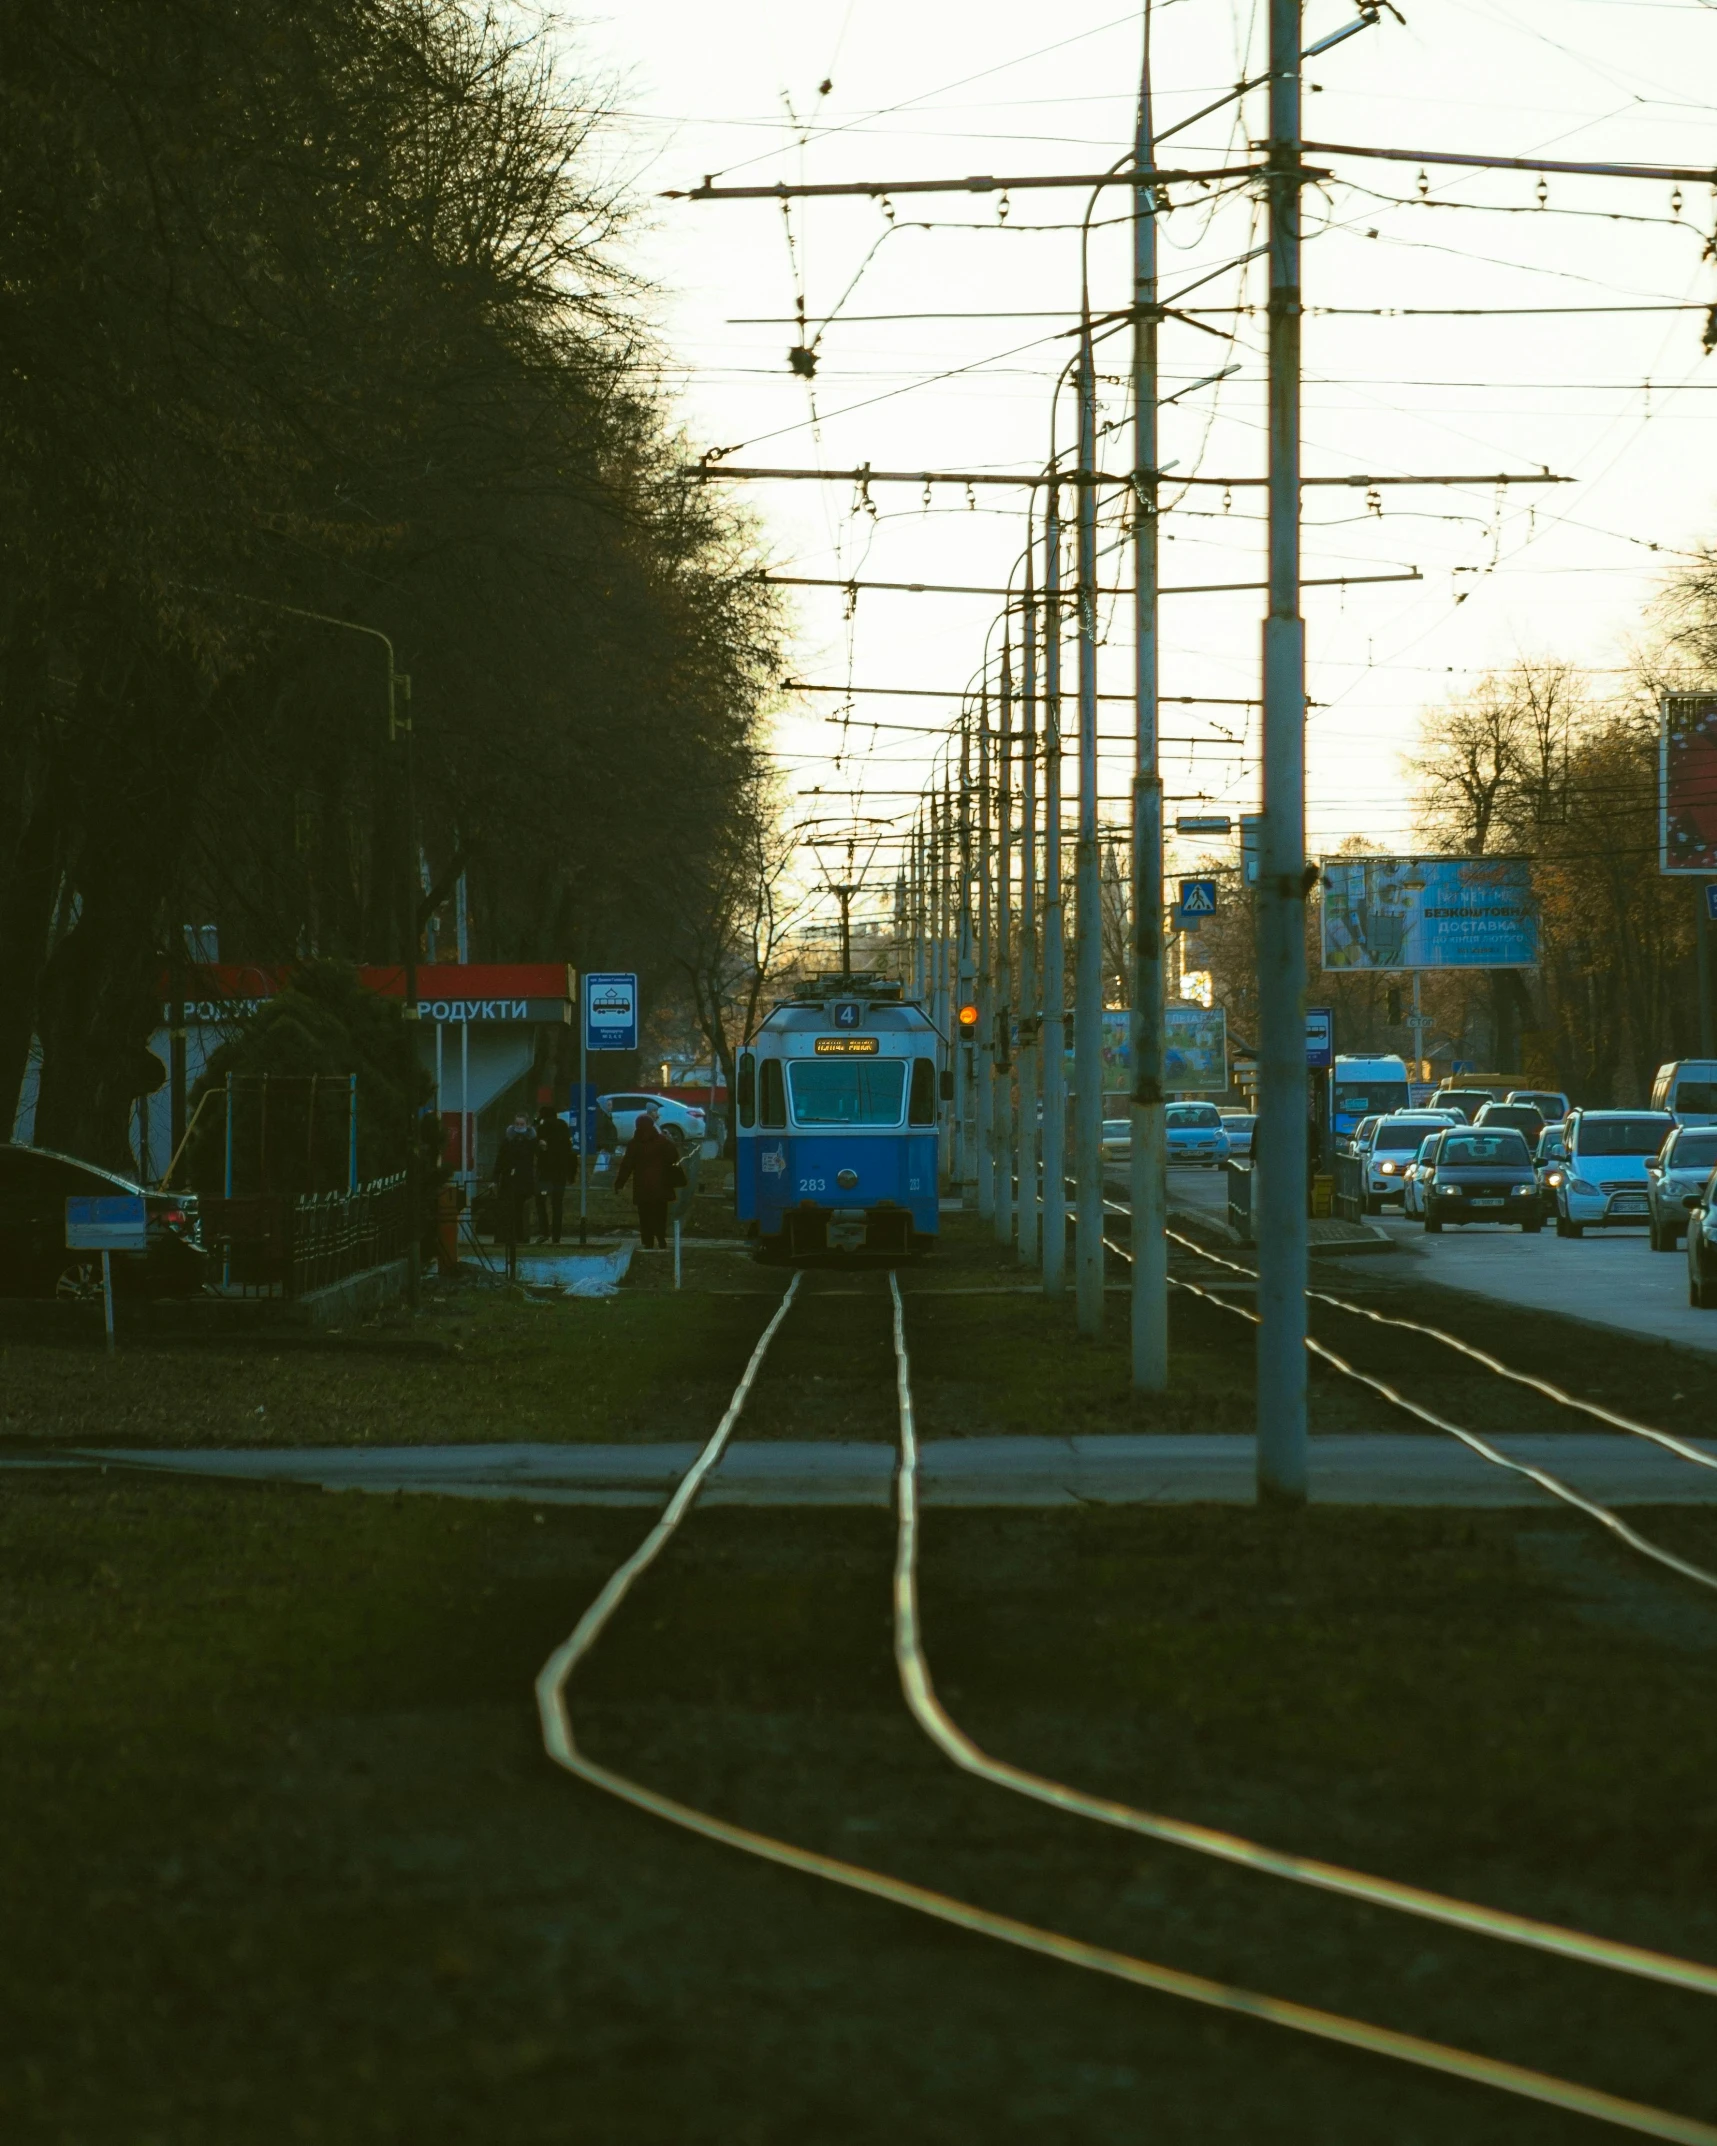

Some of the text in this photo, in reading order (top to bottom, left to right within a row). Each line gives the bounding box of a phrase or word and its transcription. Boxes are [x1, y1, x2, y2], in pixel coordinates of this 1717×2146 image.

[1424, 907, 1531, 919] БЕЗКОШТОВНА
[1438, 921, 1516, 934] ДОСТАВКА
[402, 1000, 527, 1022] РОДУКТИ
[840, 1006, 854, 1024] 4
[799, 1179, 826, 1191] 283
[909, 1178, 920, 1191] 283
